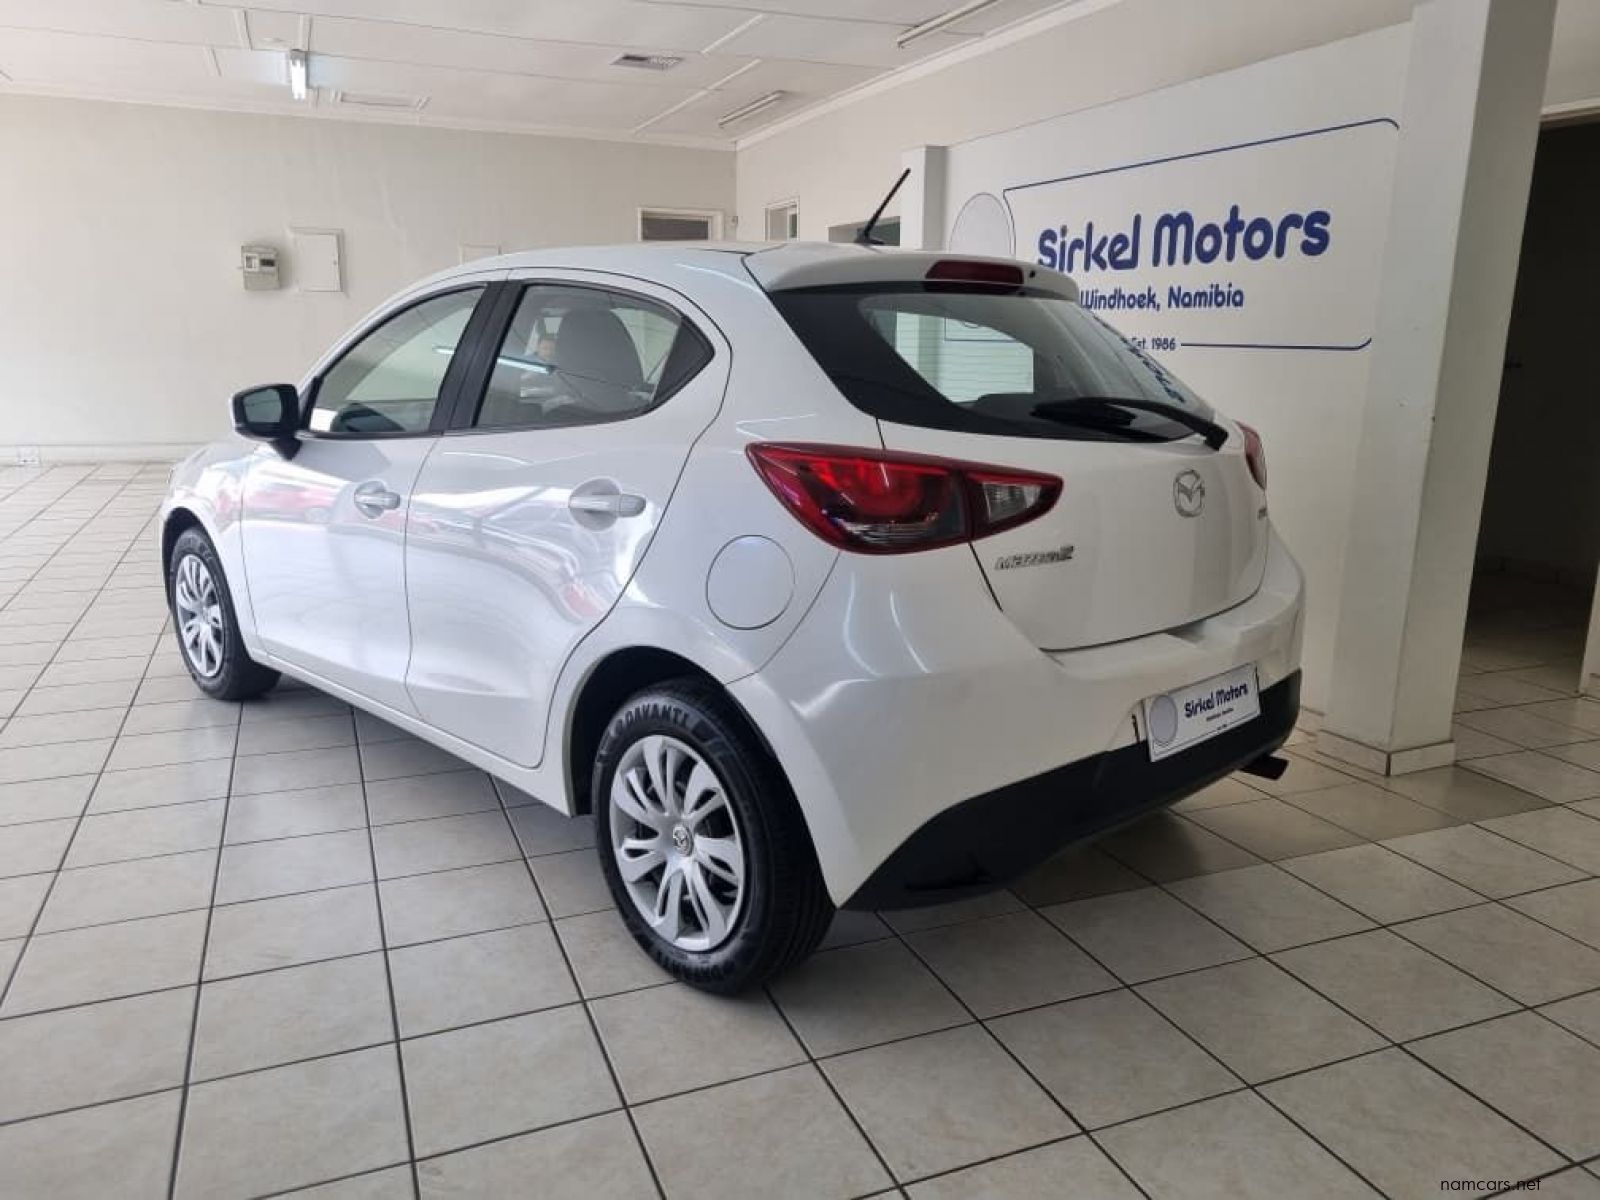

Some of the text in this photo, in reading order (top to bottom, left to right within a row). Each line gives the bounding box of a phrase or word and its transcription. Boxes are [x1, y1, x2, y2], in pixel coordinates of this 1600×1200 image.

[1038, 204, 1331, 273] Sirkel Motors
[1080, 282, 1244, 311] Windhoek, Namibia
[1152, 337, 1176, 351] 1986
[1185, 691, 1215, 718] Sirkel
[1216, 683, 1248, 706] Motors
